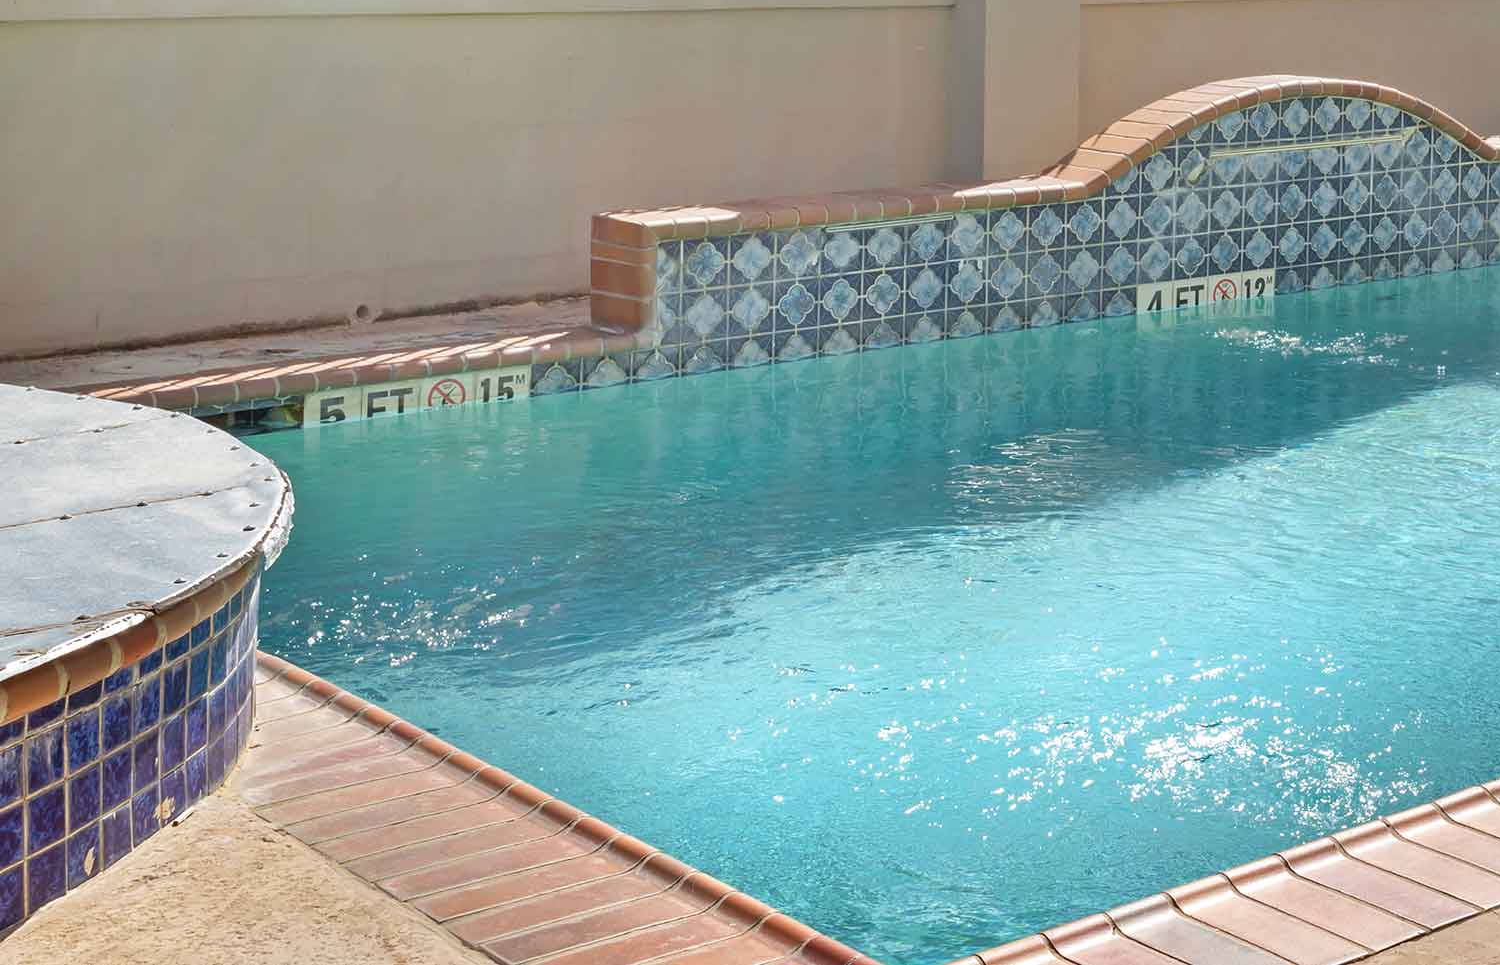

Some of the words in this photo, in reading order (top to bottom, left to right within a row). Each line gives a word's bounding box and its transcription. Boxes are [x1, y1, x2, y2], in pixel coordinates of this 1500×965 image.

[1176, 285, 1205, 308] FT
[319, 396, 347, 424] 5
[366, 387, 414, 418] FT
